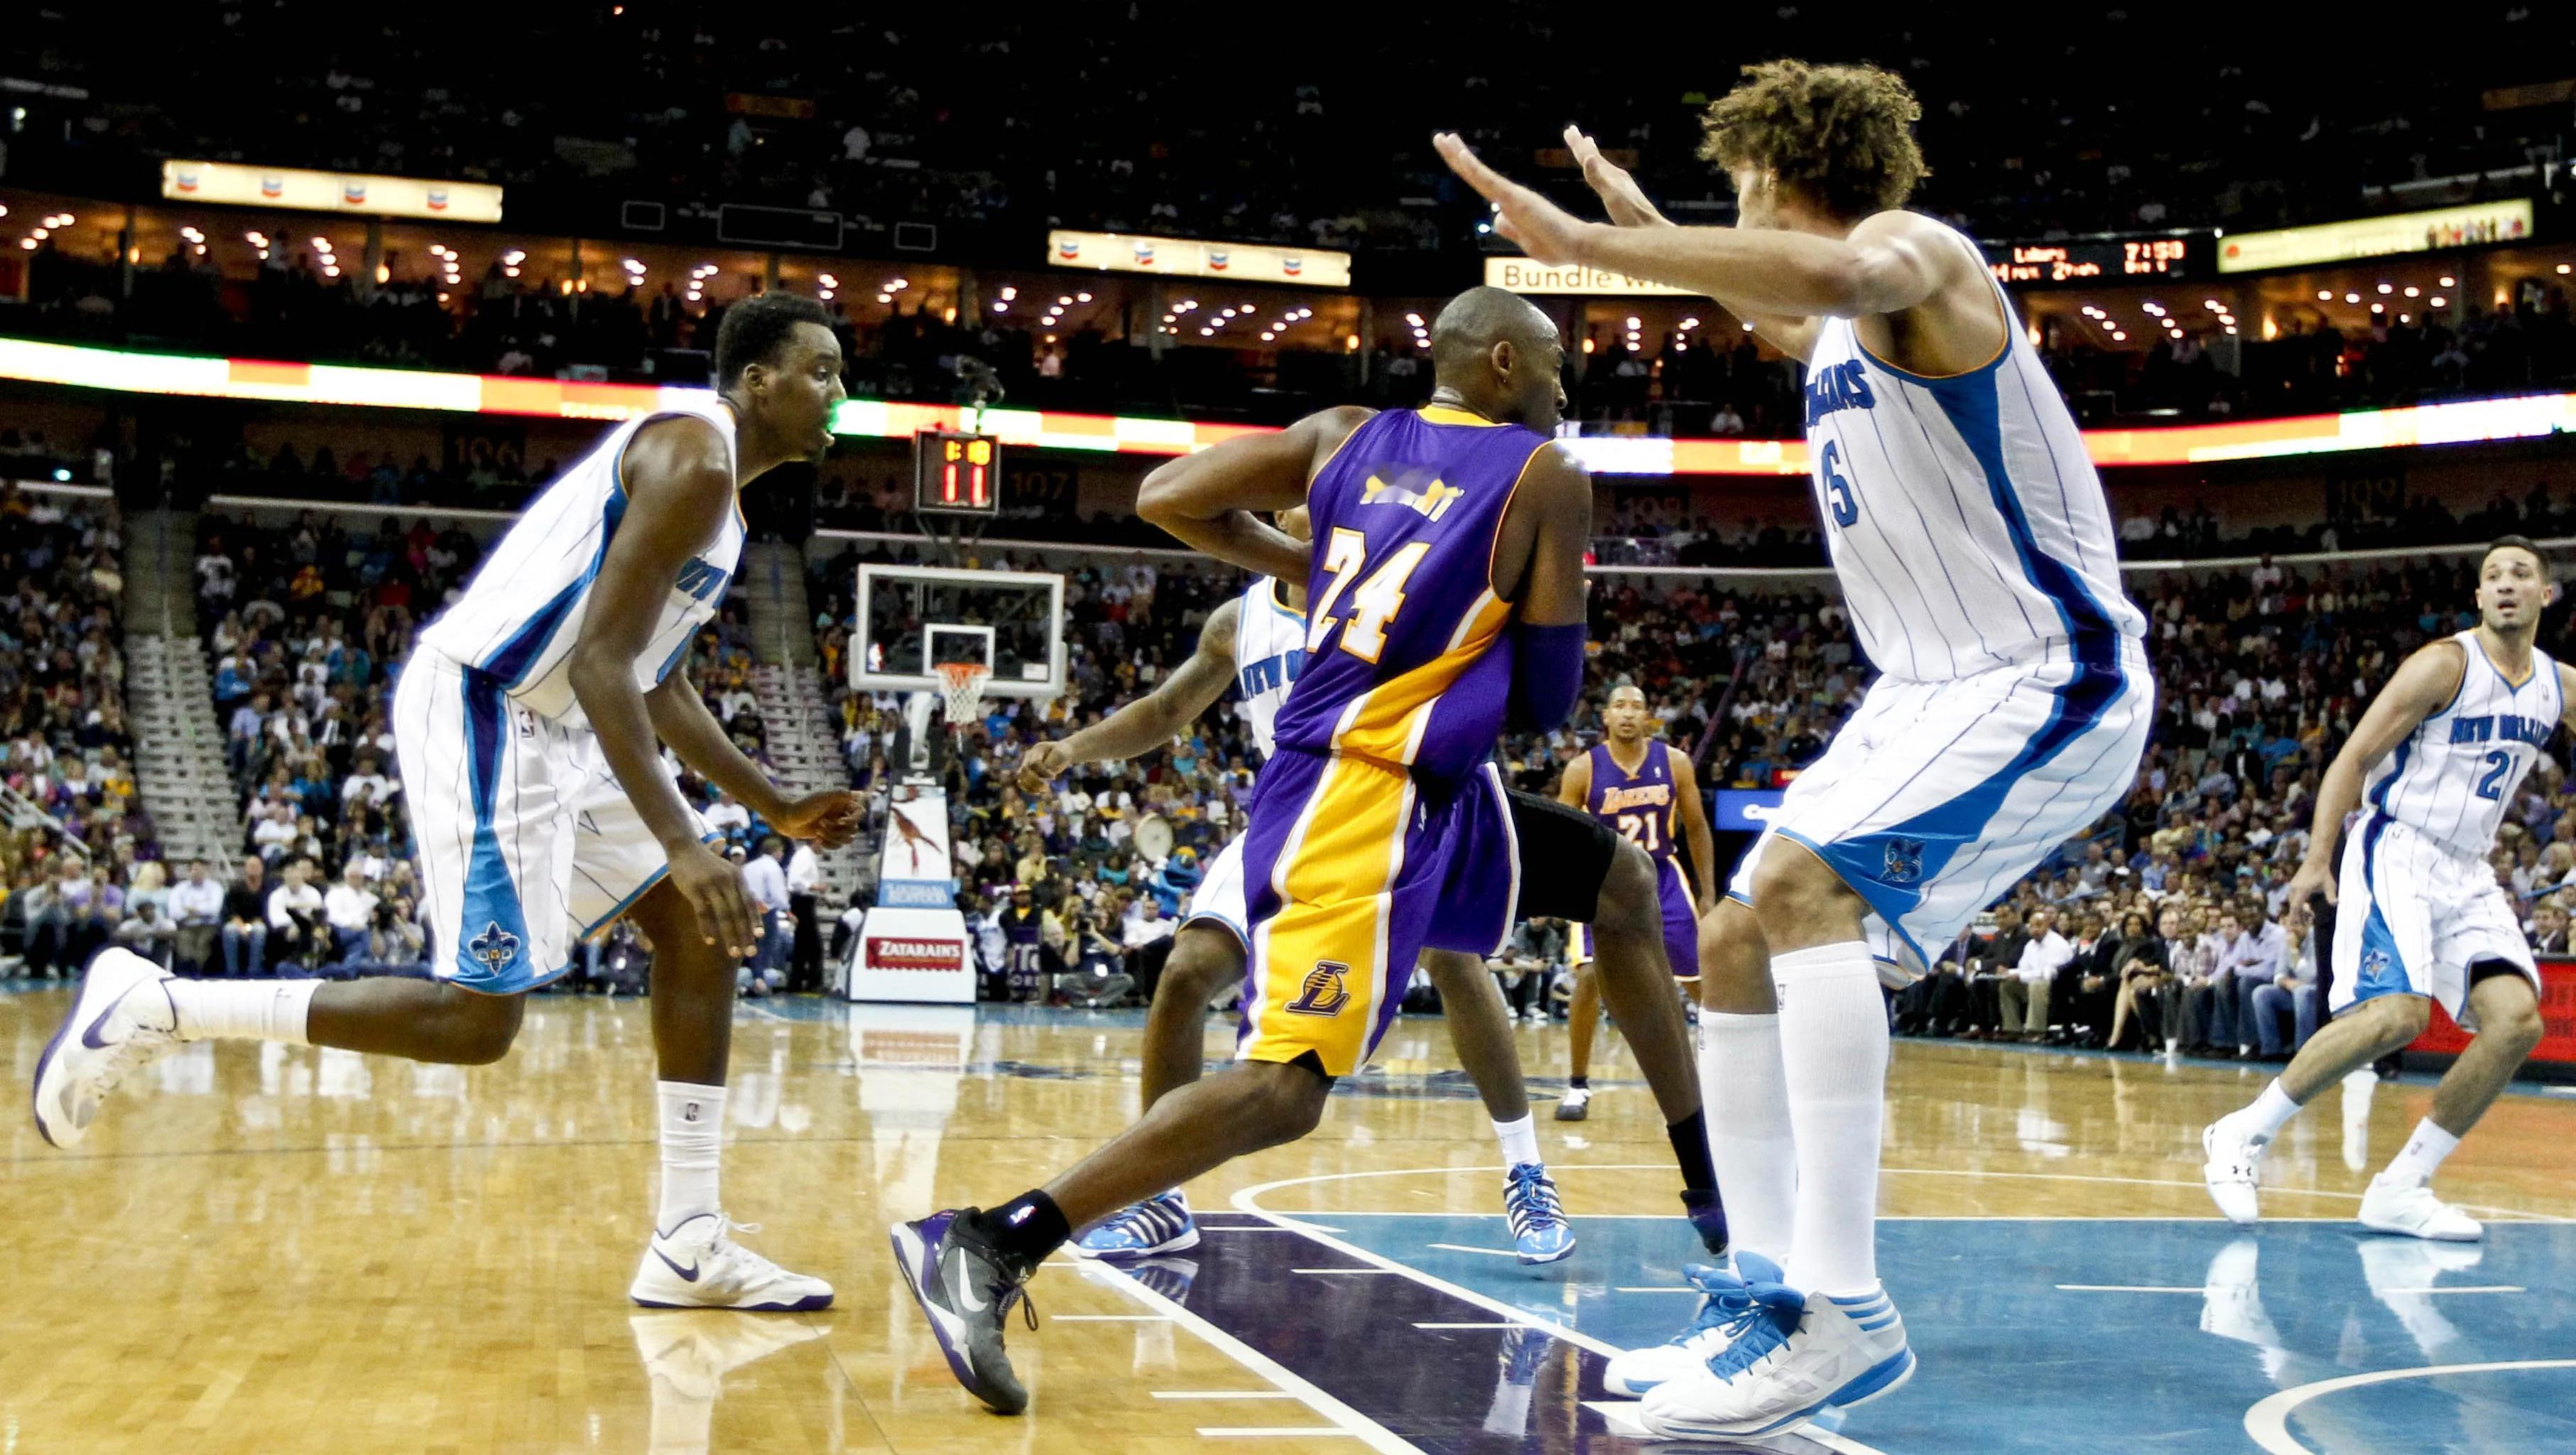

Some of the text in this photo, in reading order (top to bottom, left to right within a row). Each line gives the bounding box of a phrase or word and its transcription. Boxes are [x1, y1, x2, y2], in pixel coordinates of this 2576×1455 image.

[1504, 265, 1612, 288] Bundle
[1306, 526, 1432, 665] 24
[1242, 654, 1282, 701] NEW
[2449, 715, 2494, 744] NEW
[1617, 812, 1660, 851] 21
